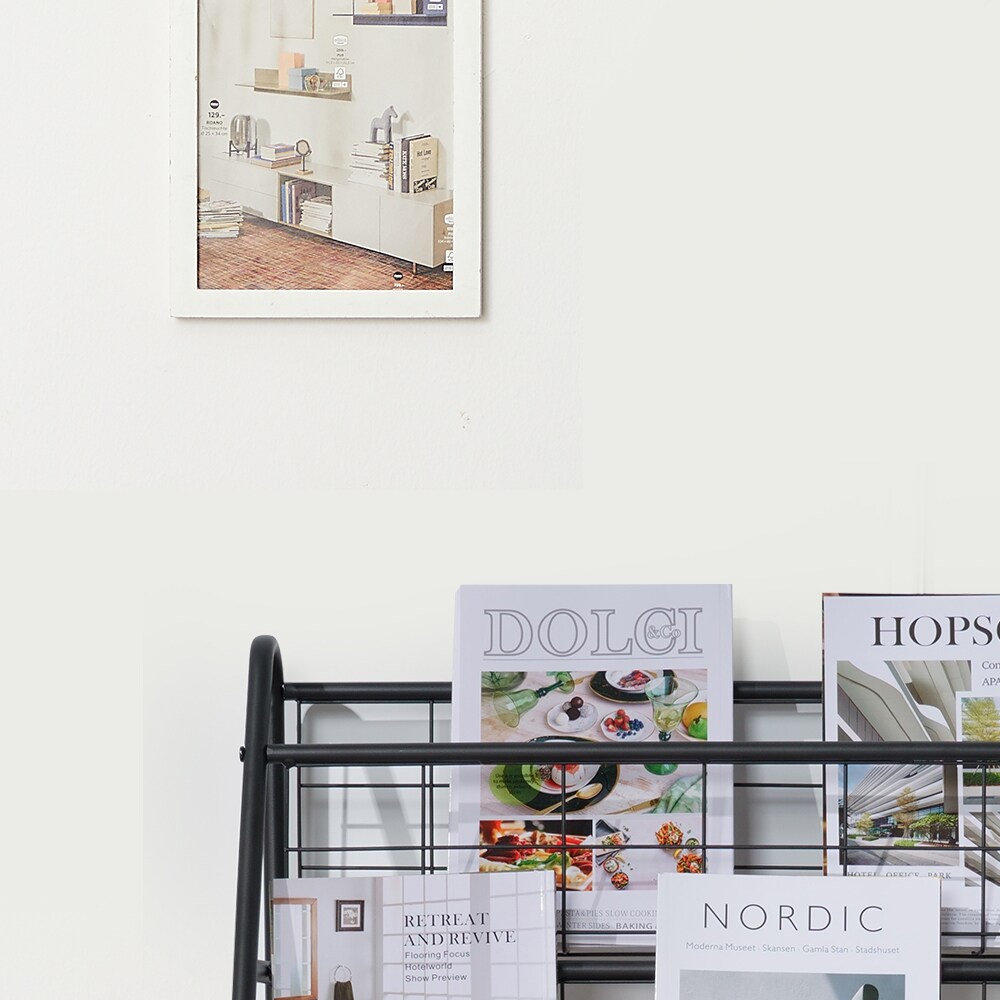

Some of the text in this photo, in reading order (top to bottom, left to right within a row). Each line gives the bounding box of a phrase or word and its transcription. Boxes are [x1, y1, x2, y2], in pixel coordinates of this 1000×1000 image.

[484, 607, 703, 657] DOLCI
[647, 625, 681, 639] &Co
[404, 912, 490, 927] RETREAT
[703, 902, 883, 933] NORDIC
[588, 922, 610, 930] SIDES
[616, 922, 653, 930] BAKING
[404, 930, 516, 946] AND REVIVE
[685, 942, 900, 954] Moderna Museet Skansen Gamla Stan Stadshuset
[405, 950, 471, 960] Flooring Focus
[405, 962, 453, 971] Hotelworld
[405, 974, 468, 982] Show Preview
